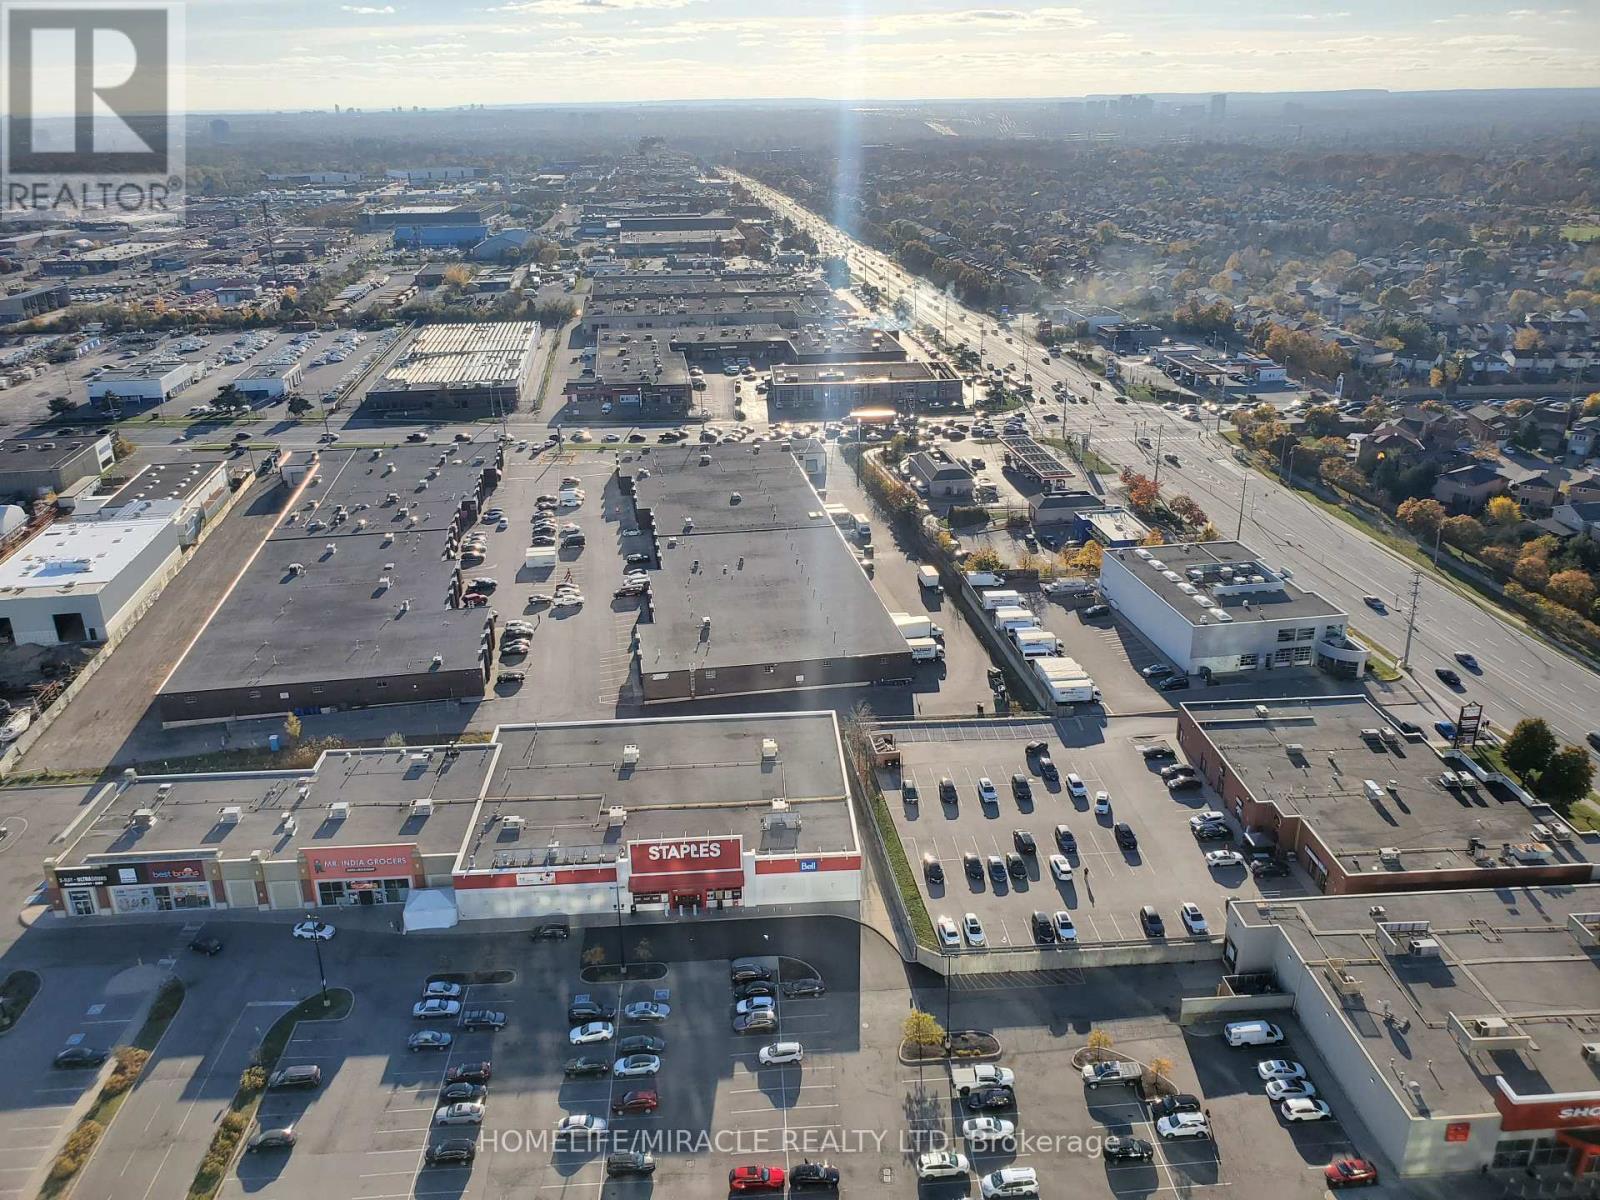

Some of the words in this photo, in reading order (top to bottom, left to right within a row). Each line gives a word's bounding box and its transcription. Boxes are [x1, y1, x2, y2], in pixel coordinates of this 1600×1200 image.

[648, 843, 721, 861] STAPLES
[341, 858, 365, 867] INDIA
[367, 857, 407, 866] GROCERS
[801, 861, 816, 870] Bell
